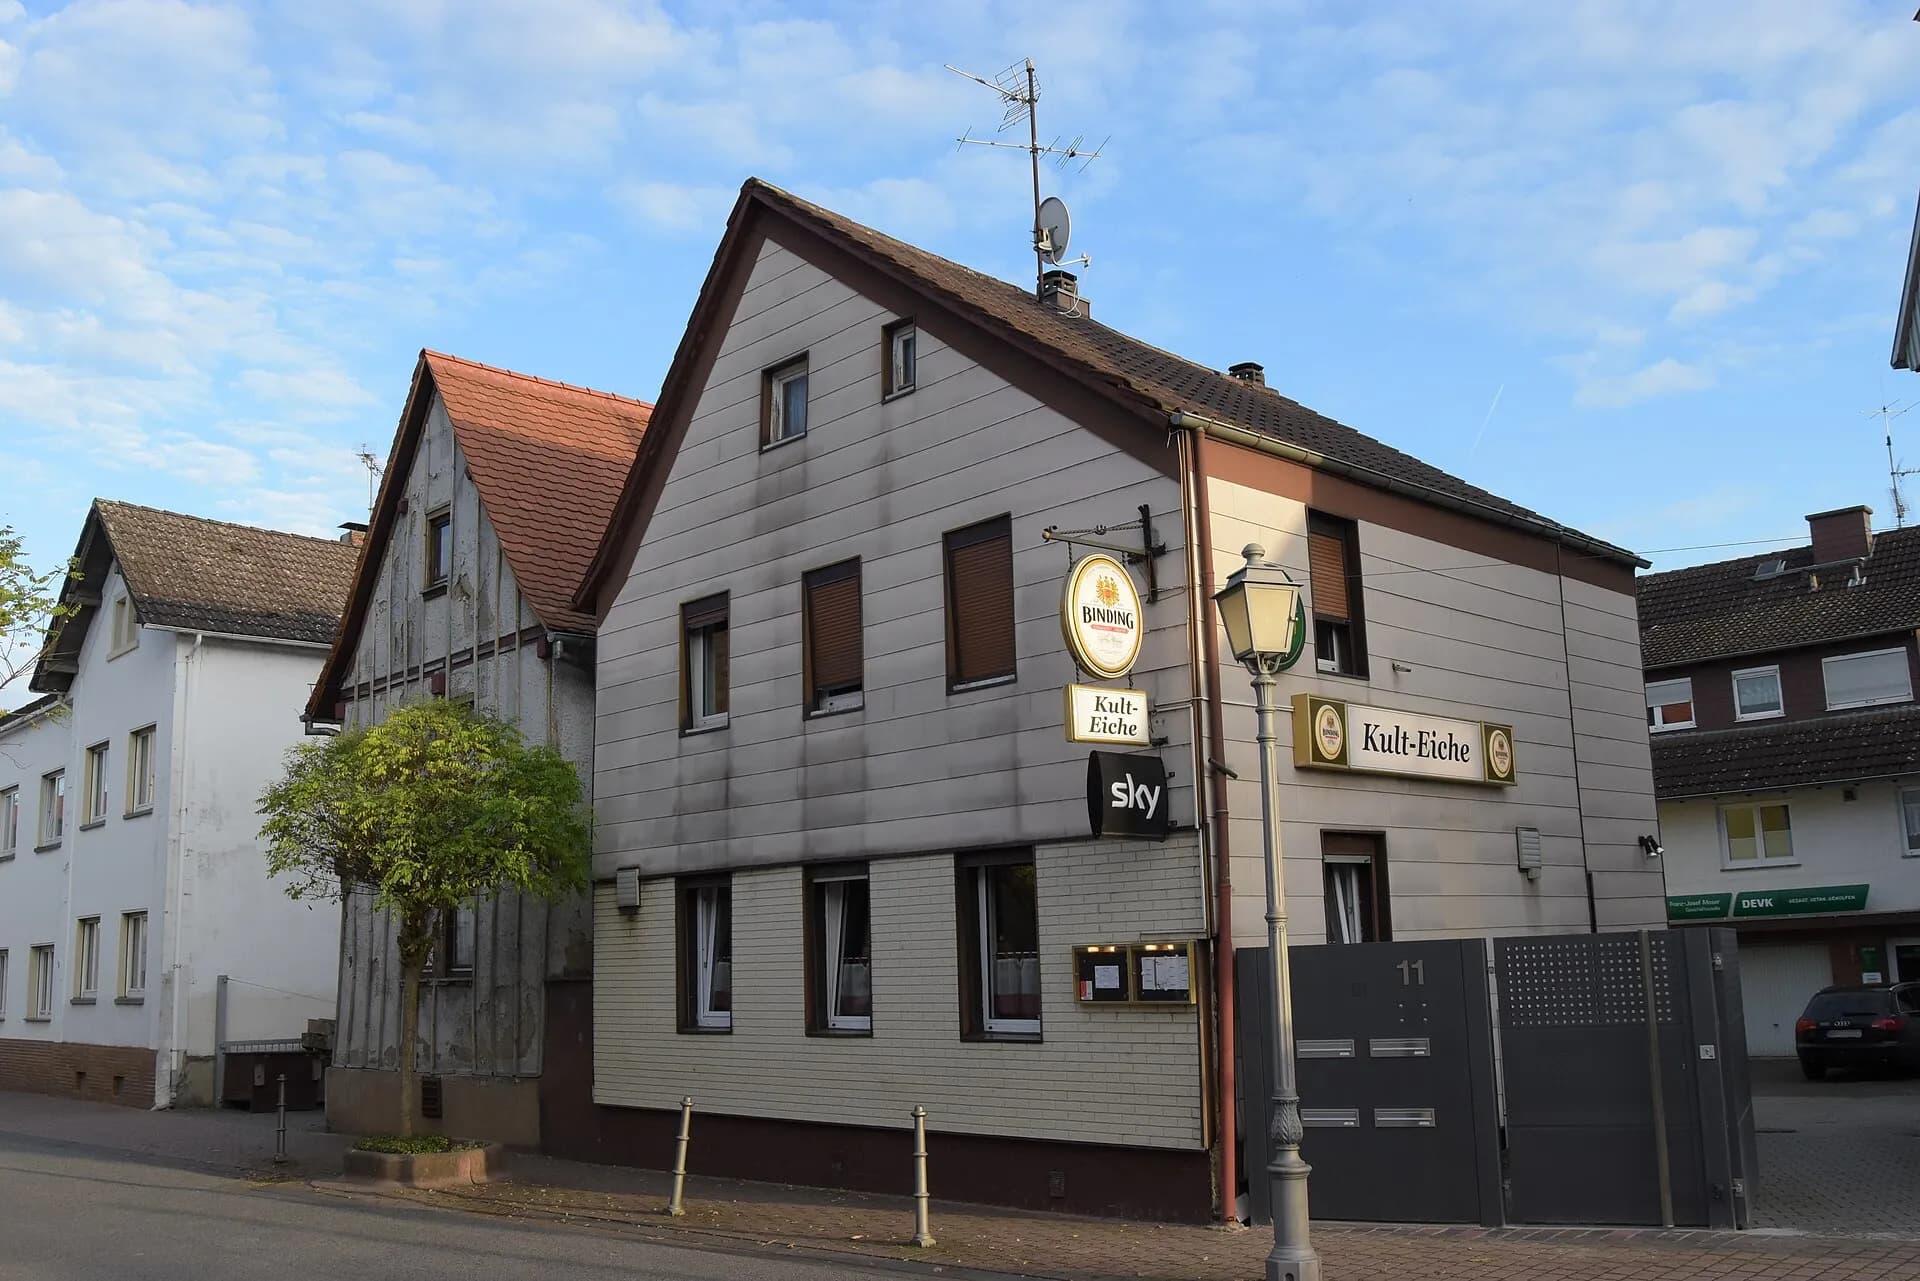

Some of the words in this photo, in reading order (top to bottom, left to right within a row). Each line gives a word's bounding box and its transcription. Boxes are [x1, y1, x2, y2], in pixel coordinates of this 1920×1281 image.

[1082, 606, 1134, 630] BINDING
[1094, 695, 1138, 717] Kult-
[1089, 716, 1138, 737] Eiche
[1362, 723, 1471, 763] Kult-Eiche
[1111, 772, 1161, 820] sky
[1742, 898, 1774, 909] DEVK
[1396, 959, 1424, 985] 11
